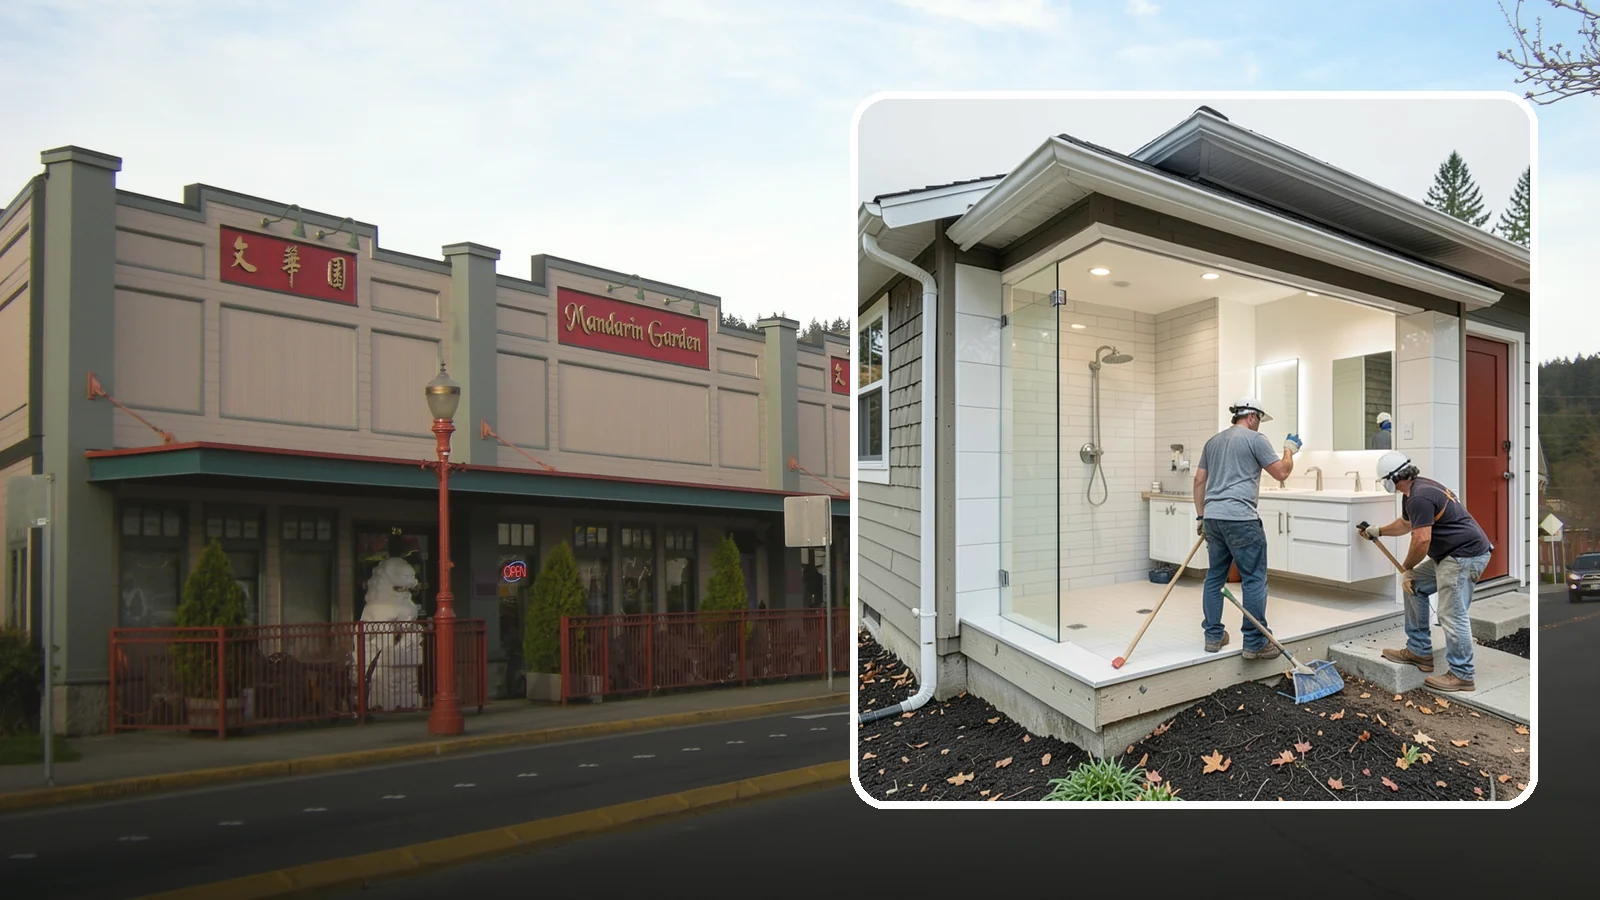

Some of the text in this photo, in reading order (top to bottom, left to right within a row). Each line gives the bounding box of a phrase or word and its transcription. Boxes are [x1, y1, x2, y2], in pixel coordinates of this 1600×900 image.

[231, 236, 346, 290] 文華園
[564, 302, 701, 352] Mandarin Garden
[503, 565, 527, 578] OPEN
